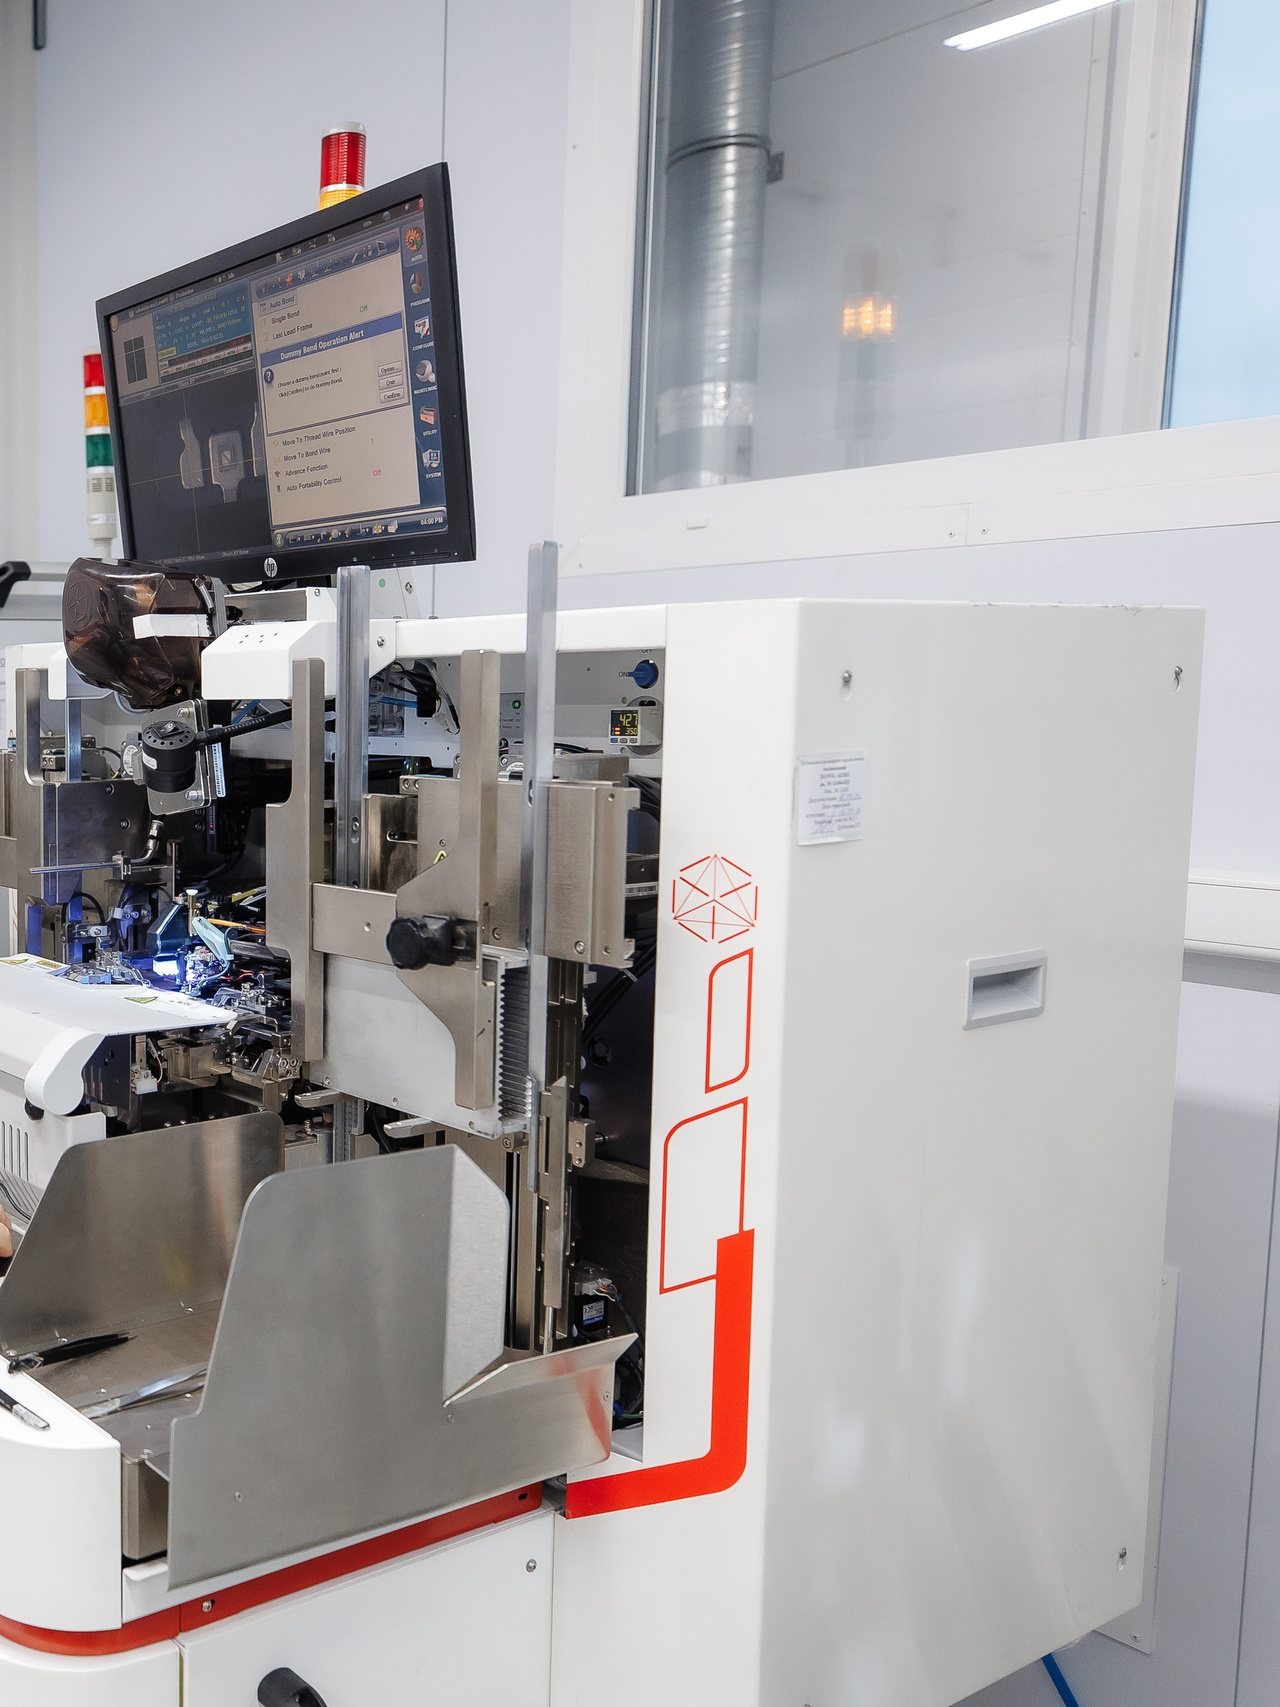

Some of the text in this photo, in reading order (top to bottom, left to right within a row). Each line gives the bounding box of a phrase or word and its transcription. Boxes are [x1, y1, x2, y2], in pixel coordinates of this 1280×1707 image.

[411, 254, 423, 262] AUTO
[270, 295, 295, 309] Auto Bond
[359, 304, 368, 313] Off
[271, 314, 285, 325] Single
[285, 309, 301, 320] Bond
[272, 330, 283, 340] Last
[283, 325, 296, 337] Lead
[296, 322, 313, 333] Frame
[280, 329, 365, 361] Dummy Bond Operation Alert
[277, 380, 292, 388] Choose
[295, 376, 309, 384] dummy
[309, 372, 320, 380] bond
[320, 369, 331, 378] point
[315, 380, 331, 389] Dummy
[383, 392, 401, 400] Confirm
[282, 437, 296, 447] Move
[296, 436, 303, 445] To
[303, 432, 321, 443] Thread
[321, 429, 334, 439] Wire
[335, 425, 356, 437] Position
[422, 428, 438, 437] UTILITY
[283, 446, 331, 462] Move To Bond Wire
[285, 463, 328, 477] Advance Function
[372, 468, 382, 477] Off
[425, 471, 442, 479] SYSTEM
[286, 475, 342, 492] Auto Portability Control
[420, 516, 444, 526] 04:00 PM
[624, 727, 638, 735] 350
